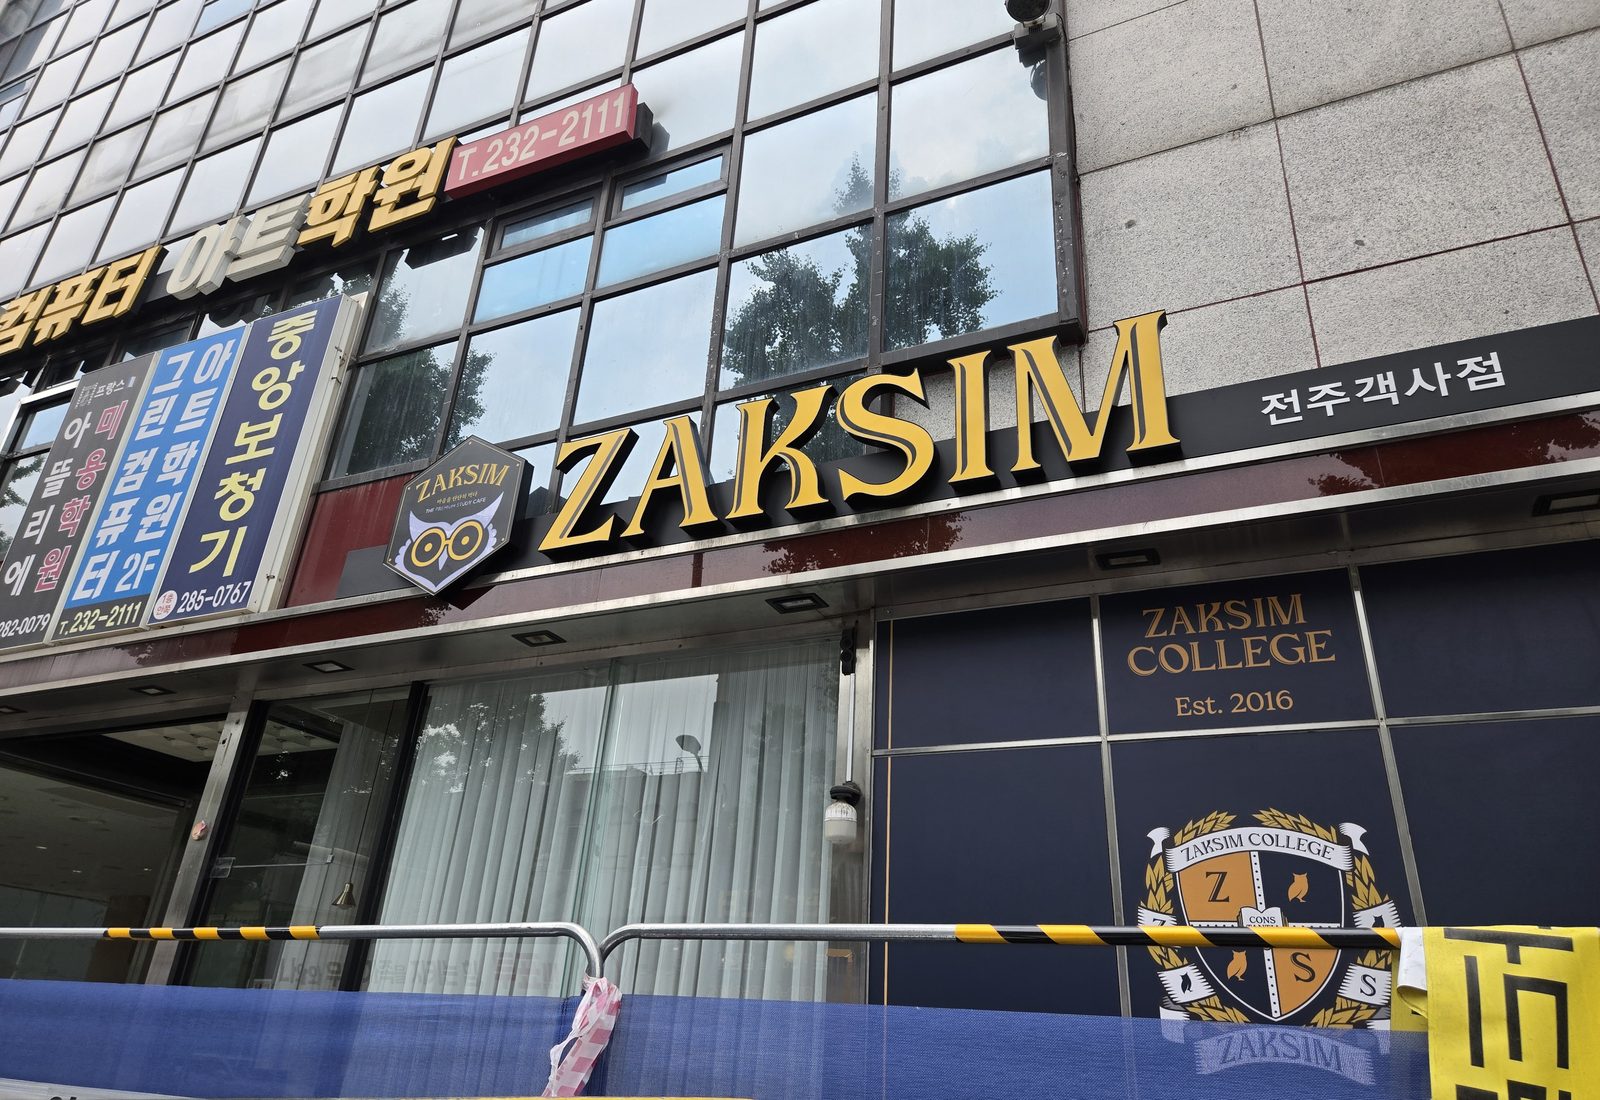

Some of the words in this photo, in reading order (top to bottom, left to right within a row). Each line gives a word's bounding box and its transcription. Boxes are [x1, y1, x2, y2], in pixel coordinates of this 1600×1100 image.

[458, 91, 625, 181] T.232-2111
[94, 380, 125, 398] 프랑스
[1260, 351, 1506, 426] 전주객사점
[188, 309, 318, 577] 중앙보청기
[538, 309, 1181, 554] ZAKSIM
[34, 399, 128, 593] 미용학원
[415, 462, 510, 503] ZAKSIM
[4, 411, 91, 597] 아뜰리에
[177, 580, 252, 613] 285-0767
[1142, 593, 1308, 639] ZAKSIM
[60, 601, 142, 636] T.232-2111
[1127, 629, 1336, 677] COLLEGE
[1175, 696, 1223, 717] Est.
[1229, 689, 1294, 714] 2016
[1180, 833, 1244, 862] ZAKSIM
[1247, 832, 1335, 861] COLLEGE
[1205, 871, 1230, 903] Z
[1249, 916, 1276, 925] CONS
[1290, 951, 1316, 983] S
[1360, 974, 1377, 996] S
[1218, 1027, 1343, 1073] ZAKSIM
